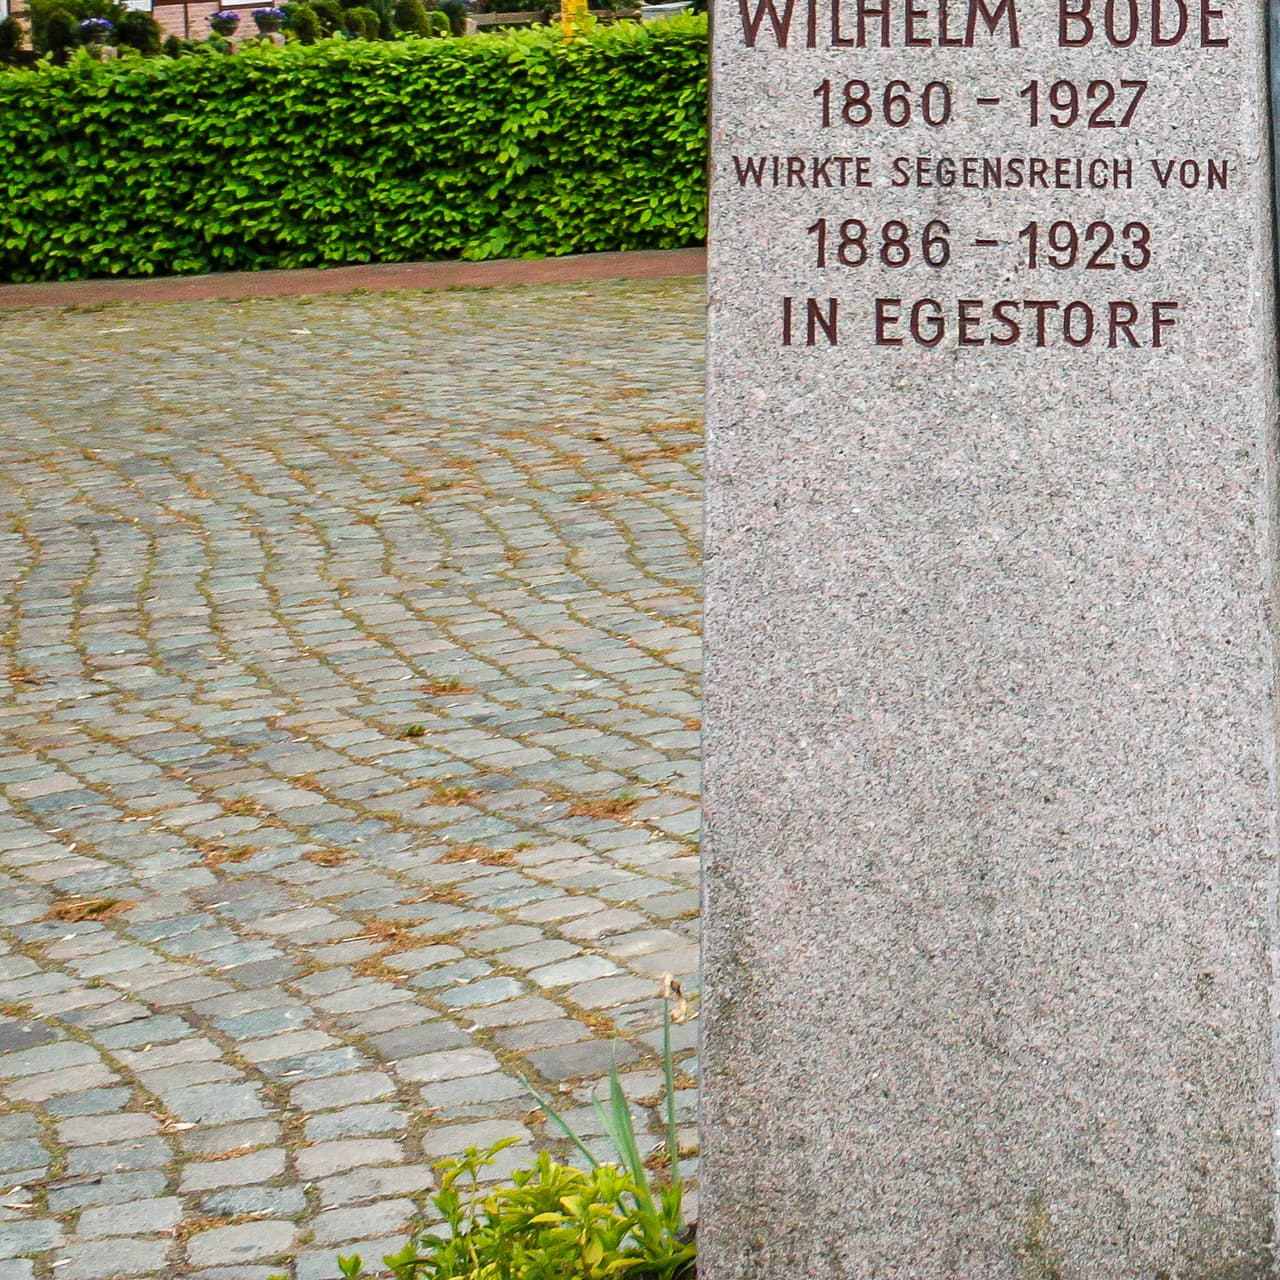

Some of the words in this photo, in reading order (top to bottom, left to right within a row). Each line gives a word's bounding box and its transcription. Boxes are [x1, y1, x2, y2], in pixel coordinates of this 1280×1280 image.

[813, 79, 953, 129] 1860
[1020, 79, 1149, 129] 1927
[734, 155, 873, 188] WIRKTE
[891, 156, 1134, 190] SEGENSREICH
[1153, 158, 1229, 190] VON
[807, 217, 951, 269] 1886
[1018, 220, 1152, 272] 1923
[782, 296, 840, 346] IN
[875, 297, 1179, 349] EGESTORF
